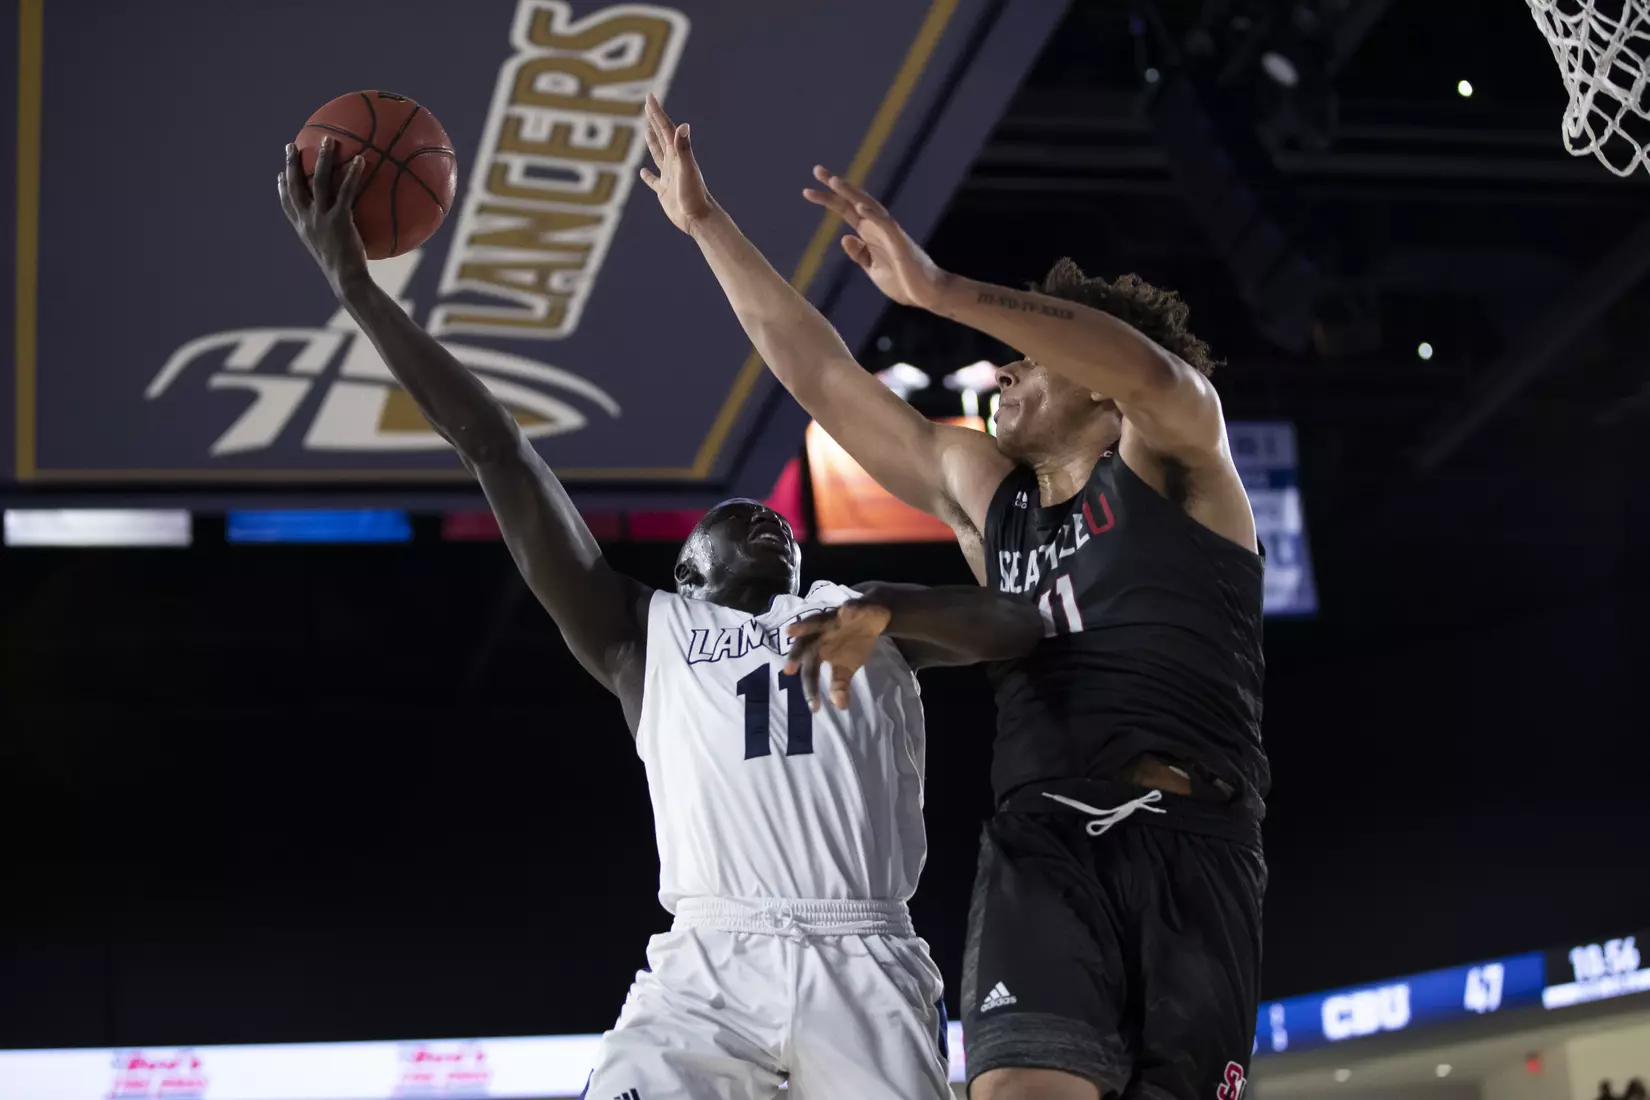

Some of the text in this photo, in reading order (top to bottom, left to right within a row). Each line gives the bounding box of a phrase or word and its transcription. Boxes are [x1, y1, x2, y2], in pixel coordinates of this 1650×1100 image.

[427, 0, 691, 340] LANCERS
[1038, 573, 1084, 638] 11
[736, 662, 814, 760] 11
[980, 995, 1017, 1012] adidas
